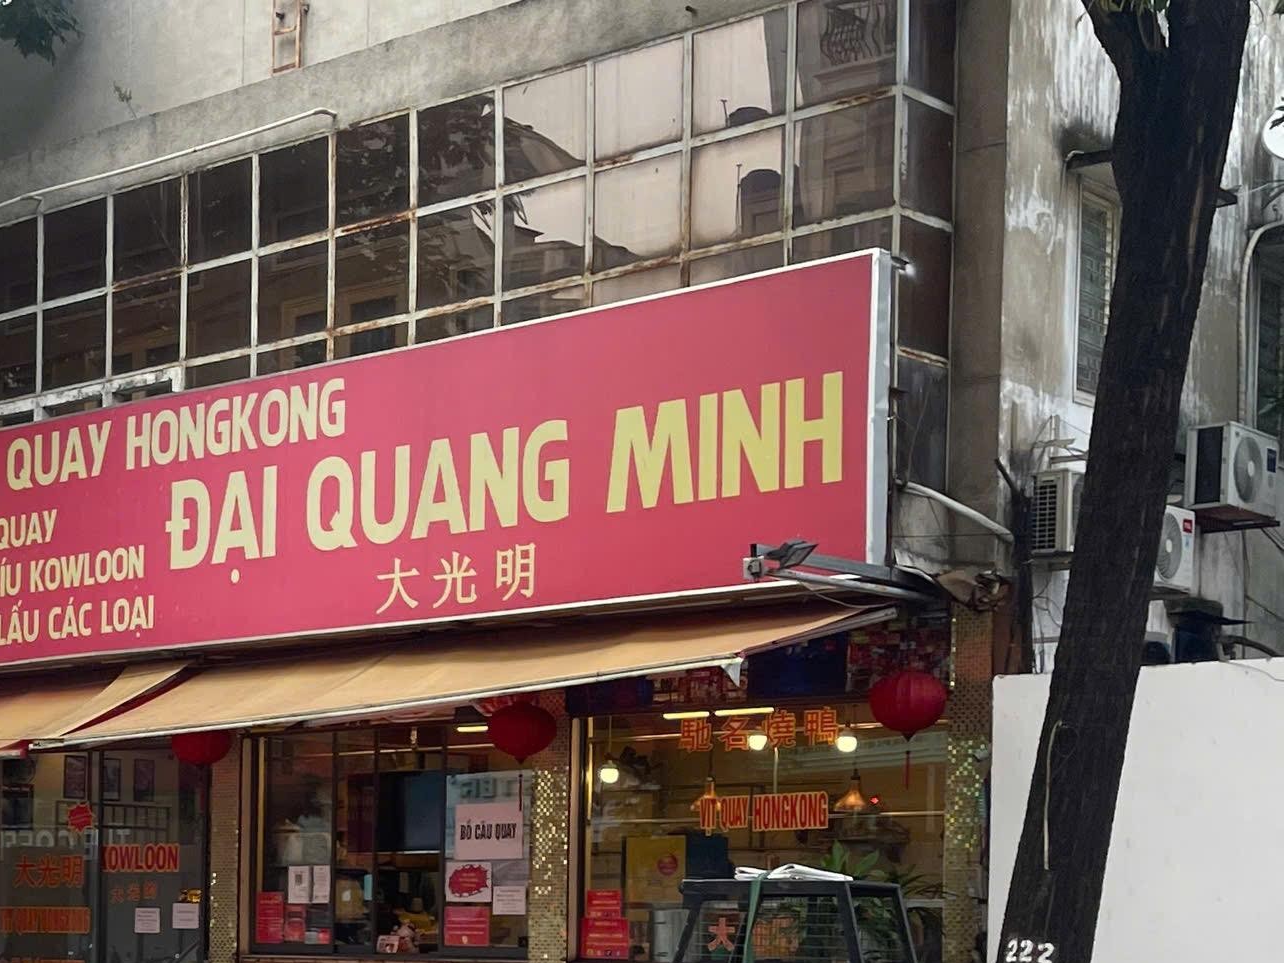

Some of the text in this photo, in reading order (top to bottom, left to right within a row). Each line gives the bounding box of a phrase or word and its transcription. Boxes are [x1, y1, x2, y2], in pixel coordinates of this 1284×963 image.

[6, 421, 112, 489] QUAY
[126, 378, 346, 470] HONGKONG
[166, 371, 843, 583] ĐẠI QUANG MINH
[29, 545, 145, 593] KOWLOON
[375, 543, 537, 615] 大光明
[48, 597, 93, 640] CÁC
[101, 595, 155, 638] LOẠI
[699, 791, 829, 836] VỊT QUAY HONGKONG
